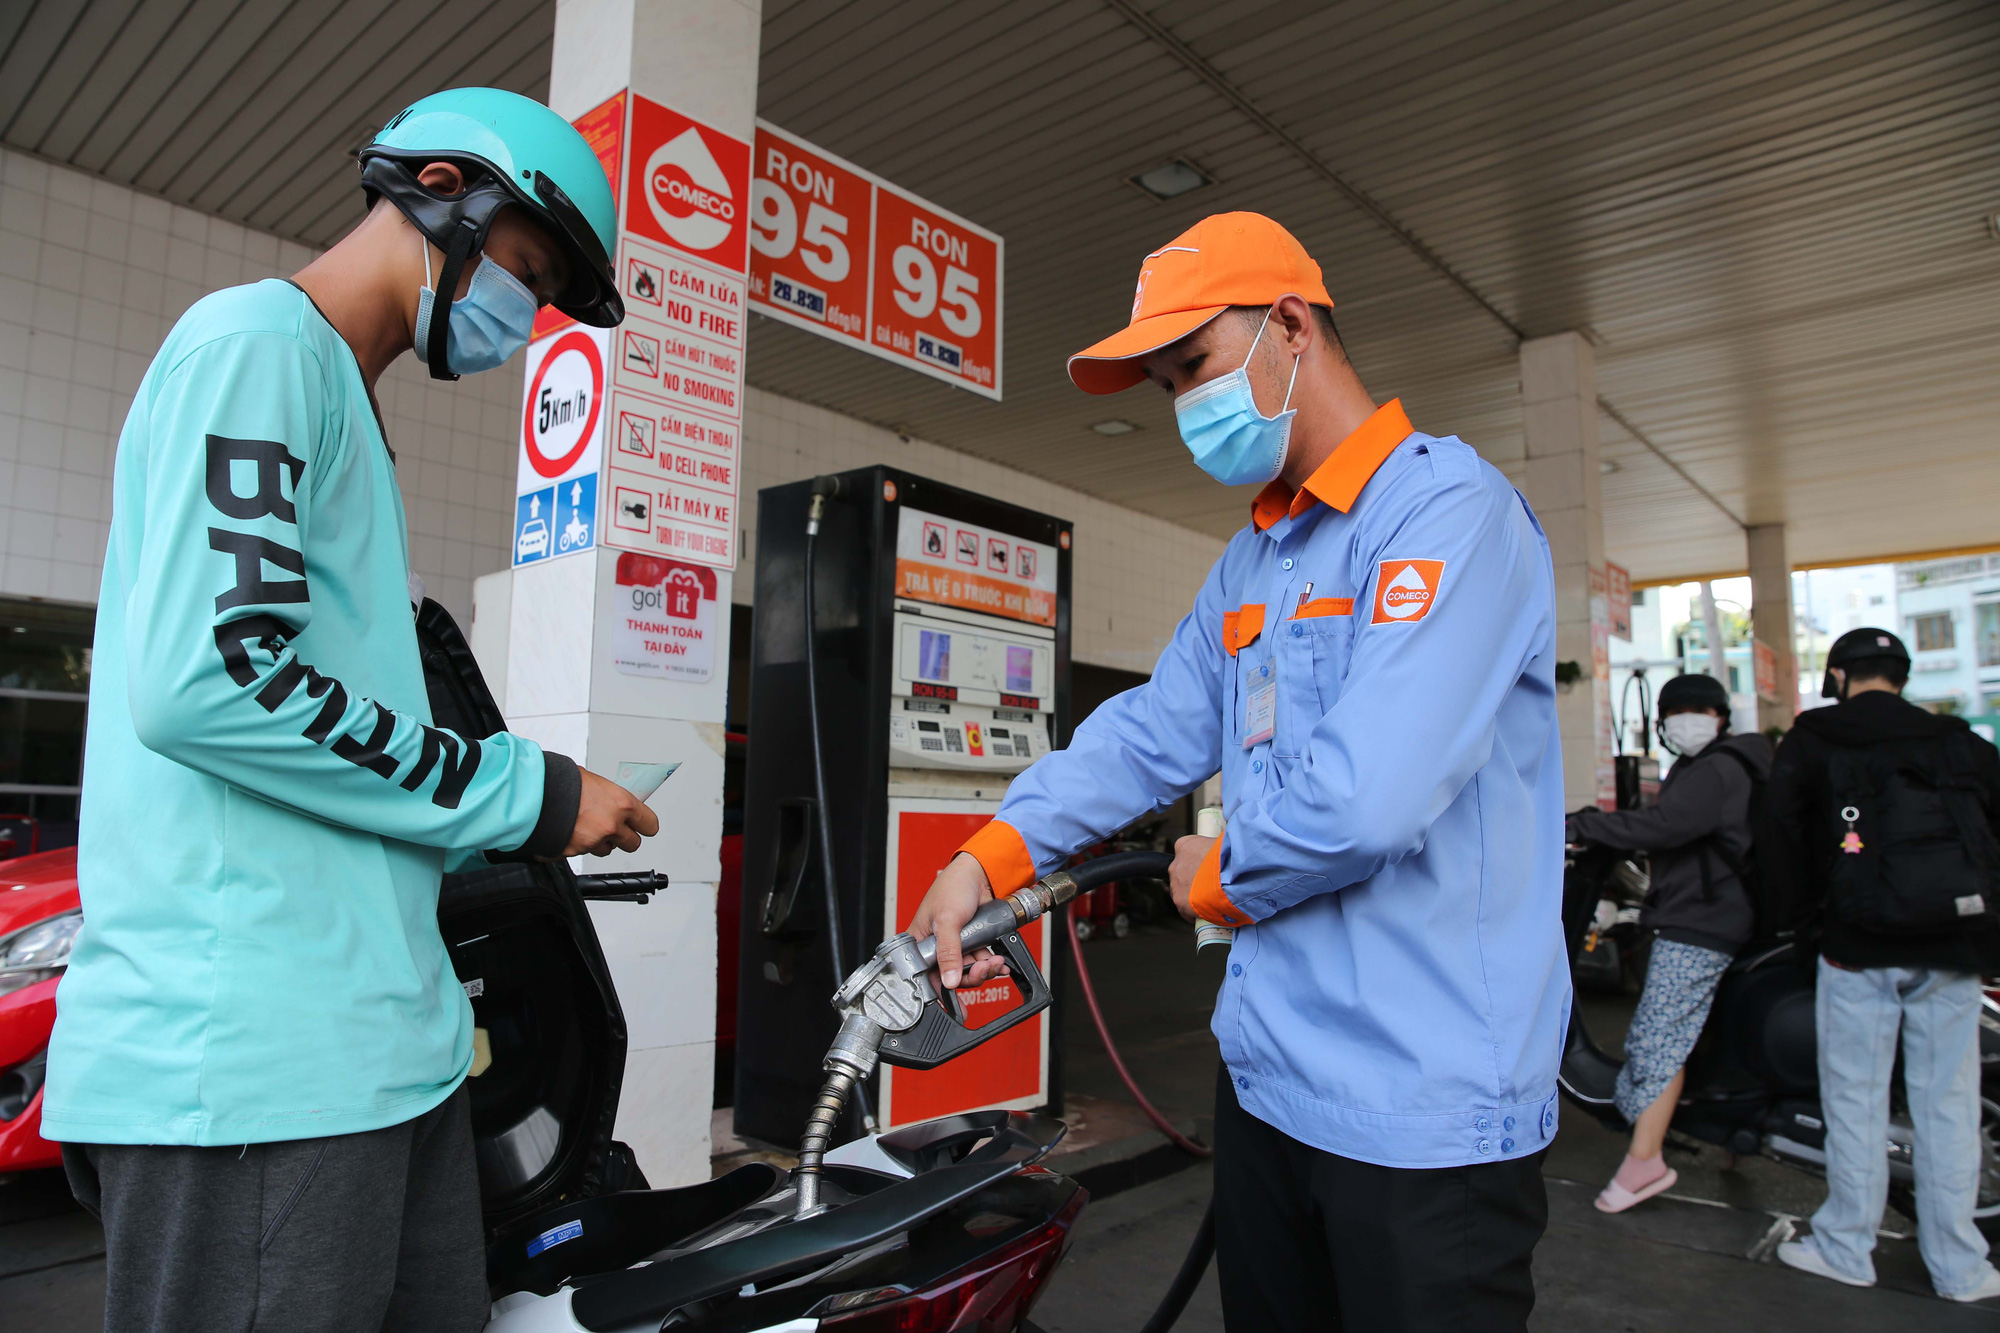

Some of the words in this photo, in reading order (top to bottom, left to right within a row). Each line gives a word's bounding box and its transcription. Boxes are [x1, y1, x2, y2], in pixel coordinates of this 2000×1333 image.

[766, 148, 834, 205] RON
[653, 174, 735, 220] COMECO
[750, 178, 850, 282] 95
[912, 216, 968, 267] RON
[669, 266, 704, 295] CẤM
[710, 282, 738, 307] LỬA
[892, 245, 982, 338] 95
[667, 300, 692, 324] NO
[699, 311, 738, 340] FIRE
[665, 338, 686, 359] CẤM
[663, 372, 680, 391] NO
[684, 378, 735, 407] SMOKING
[539, 388, 586, 435] 5Km/h
[661, 414, 681, 435] CẤM
[659, 452, 672, 471] NO
[676, 456, 697, 477] CELL
[701, 462, 731, 485] PHONE
[684, 498, 710, 519] MÁY
[715, 506, 729, 523] XE
[656, 526, 672, 546] TURN
[674, 529, 685, 549] OFF
[632, 589, 662, 611] got
[676, 591, 690, 614] it
[1387, 590, 1430, 602] COMECO
[627, 619, 669, 635] THANH
[672, 625, 703, 640] TOÁN
[644, 640, 662, 654] TẠI
[664, 642, 687, 656] ĐÂY
[913, 683, 934, 697] RON
[960, 922, 984, 938] UNO
